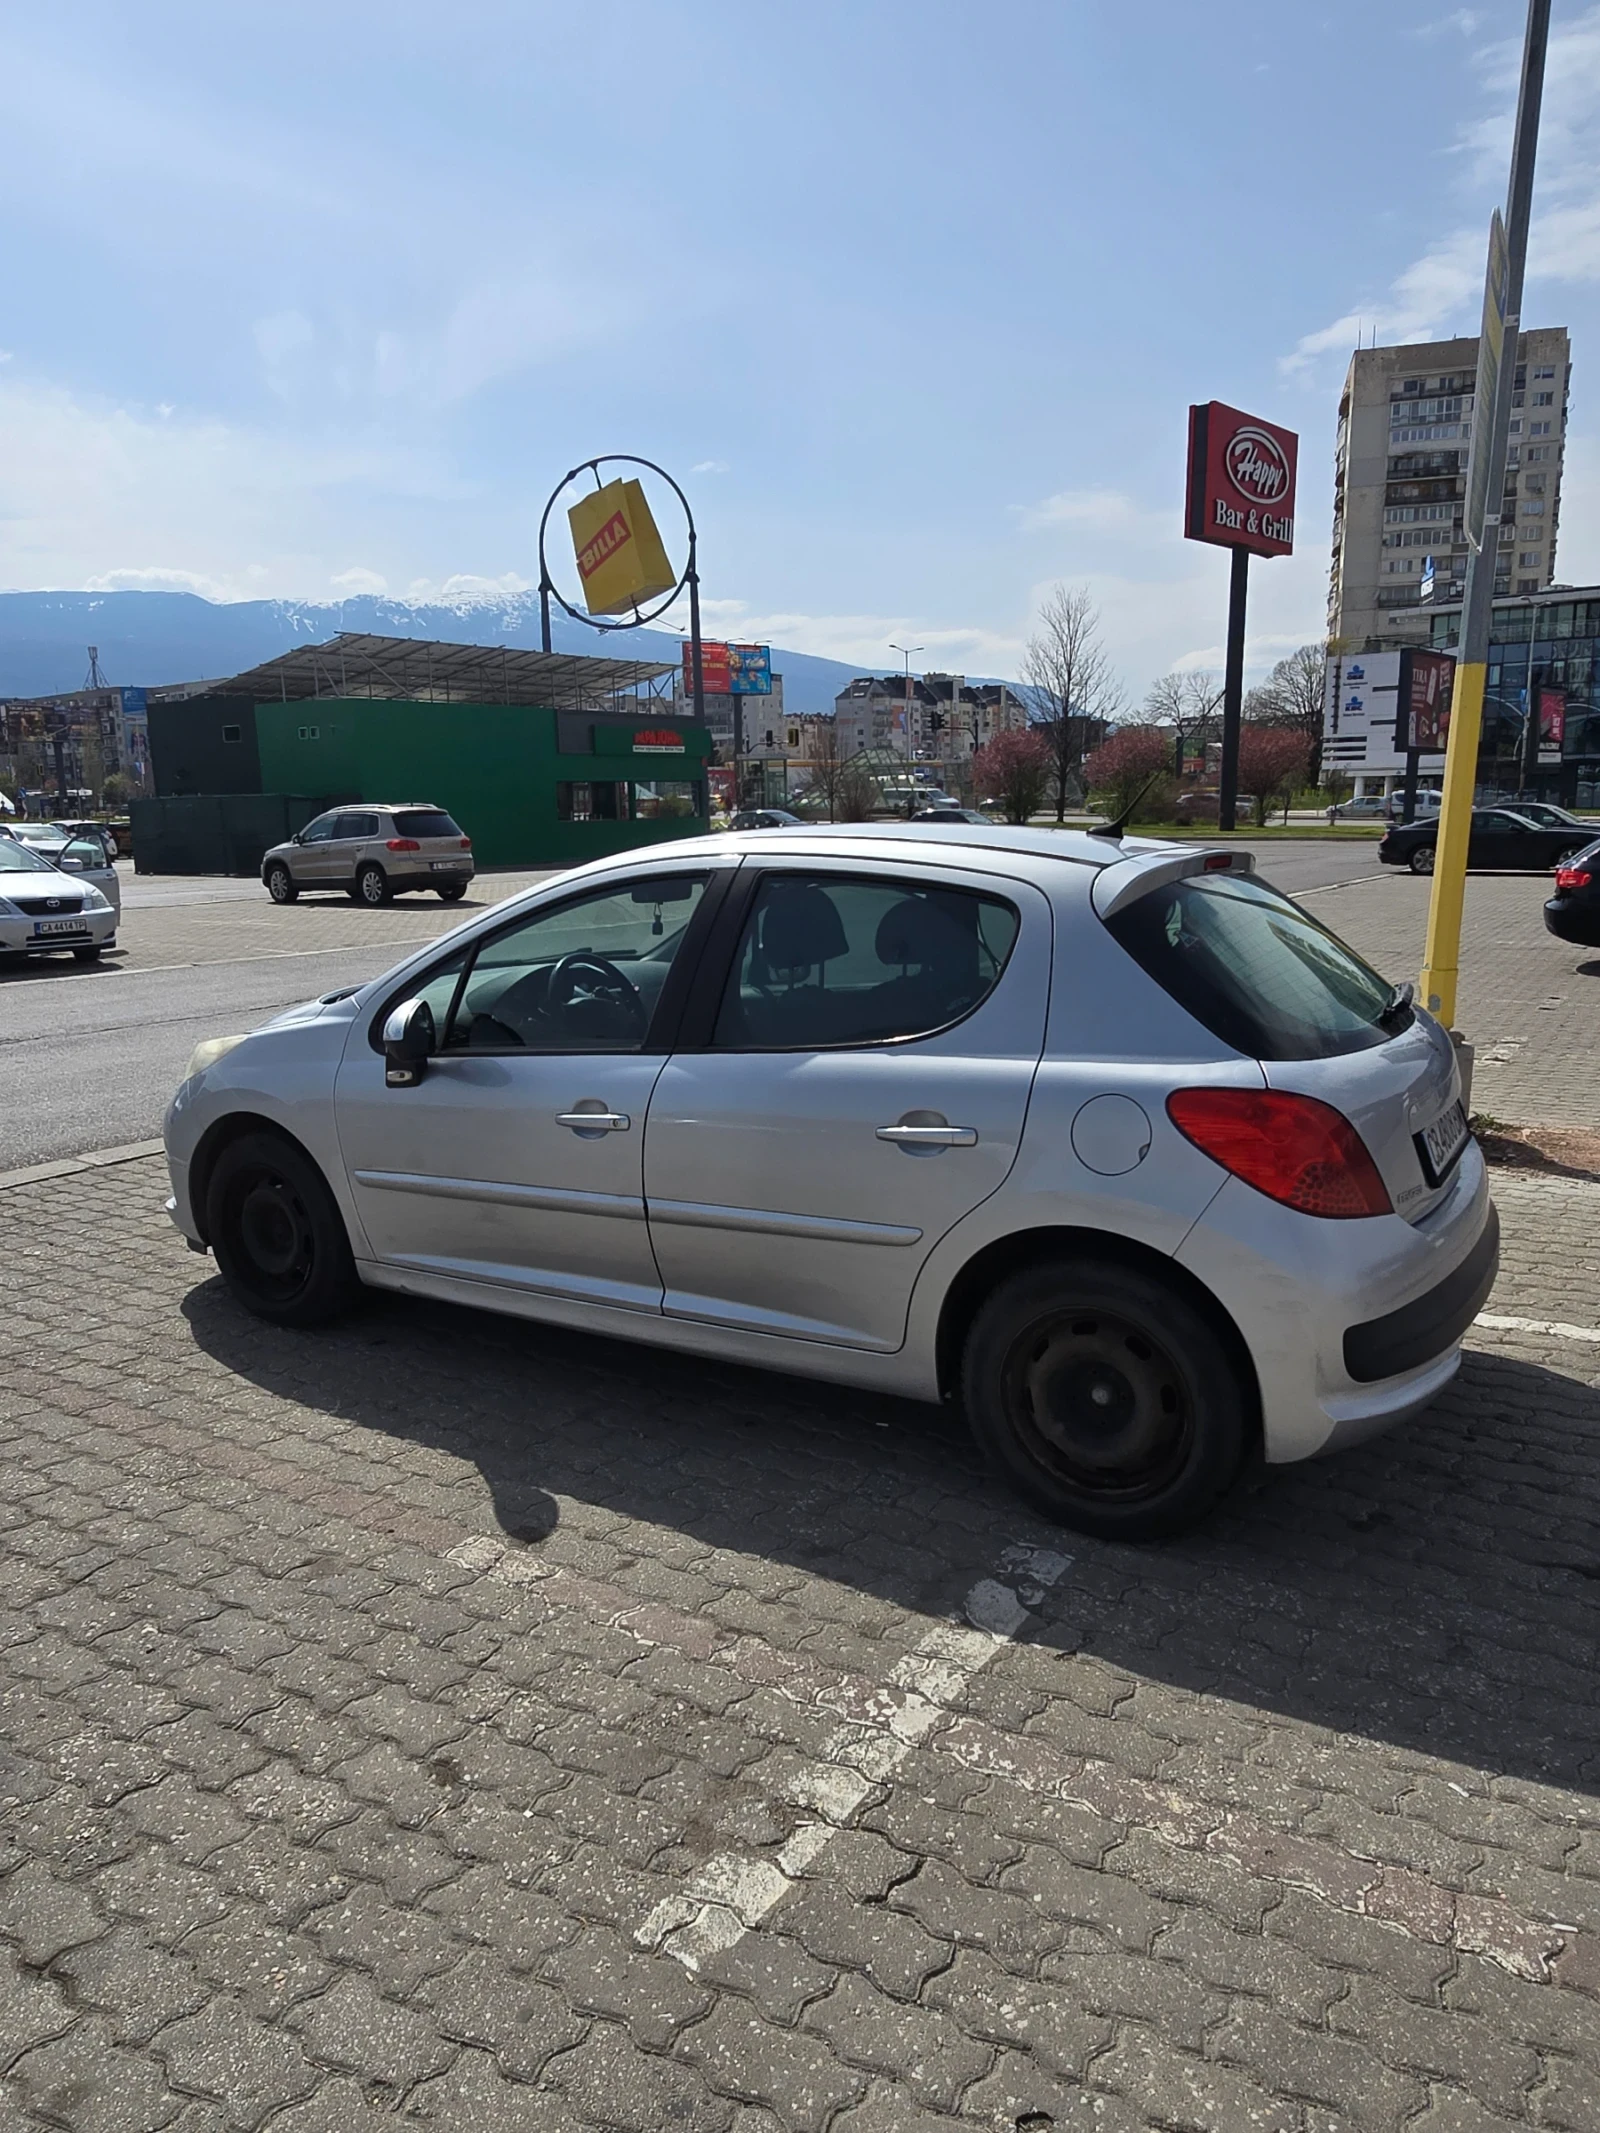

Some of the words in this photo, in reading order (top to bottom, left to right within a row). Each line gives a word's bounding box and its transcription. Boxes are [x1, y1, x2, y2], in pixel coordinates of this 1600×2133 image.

[1234, 441, 1283, 496] Happy
[580, 520, 628, 571] BILLA
[1215, 499, 1244, 529] Bar
[1247, 508, 1259, 534] &
[1262, 513, 1293, 543] Grill
